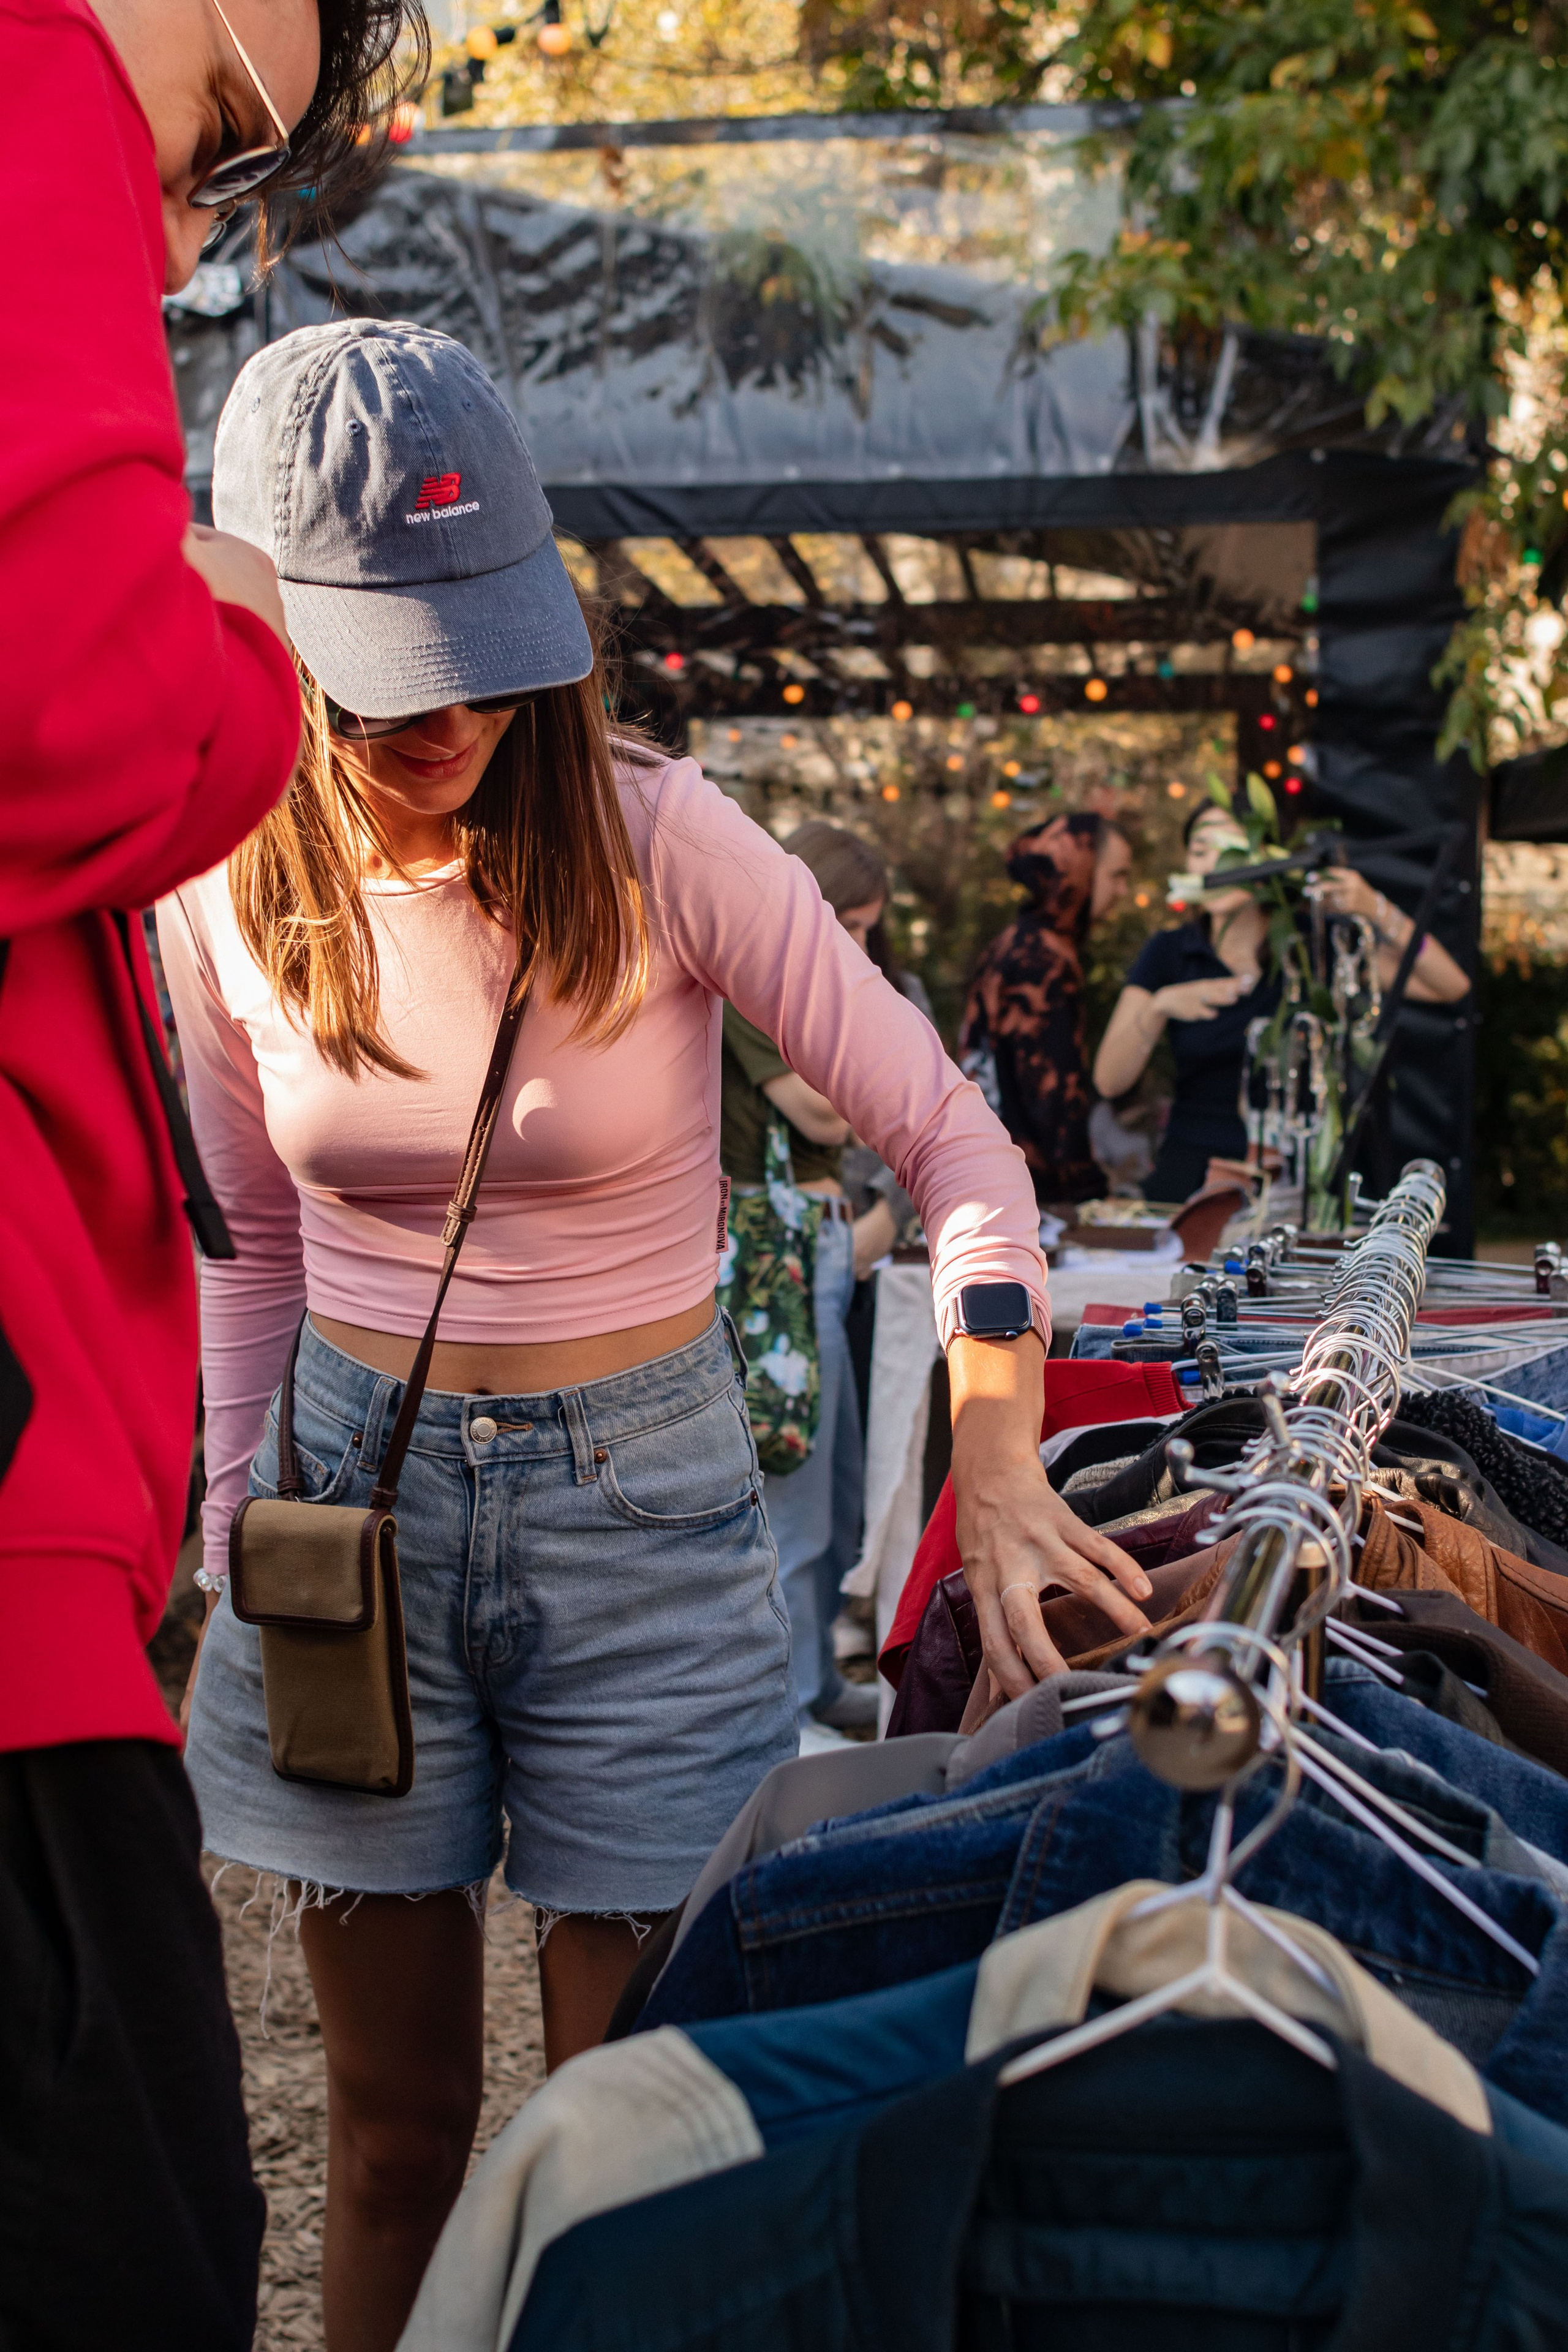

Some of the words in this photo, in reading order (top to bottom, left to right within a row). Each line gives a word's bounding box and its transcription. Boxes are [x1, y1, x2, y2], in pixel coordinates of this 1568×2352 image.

[405, 511, 430, 524] new
[432, 501, 480, 519] balance
[719, 1180, 728, 1200] IRON
[716, 1207, 727, 1250] MIRONOVA
